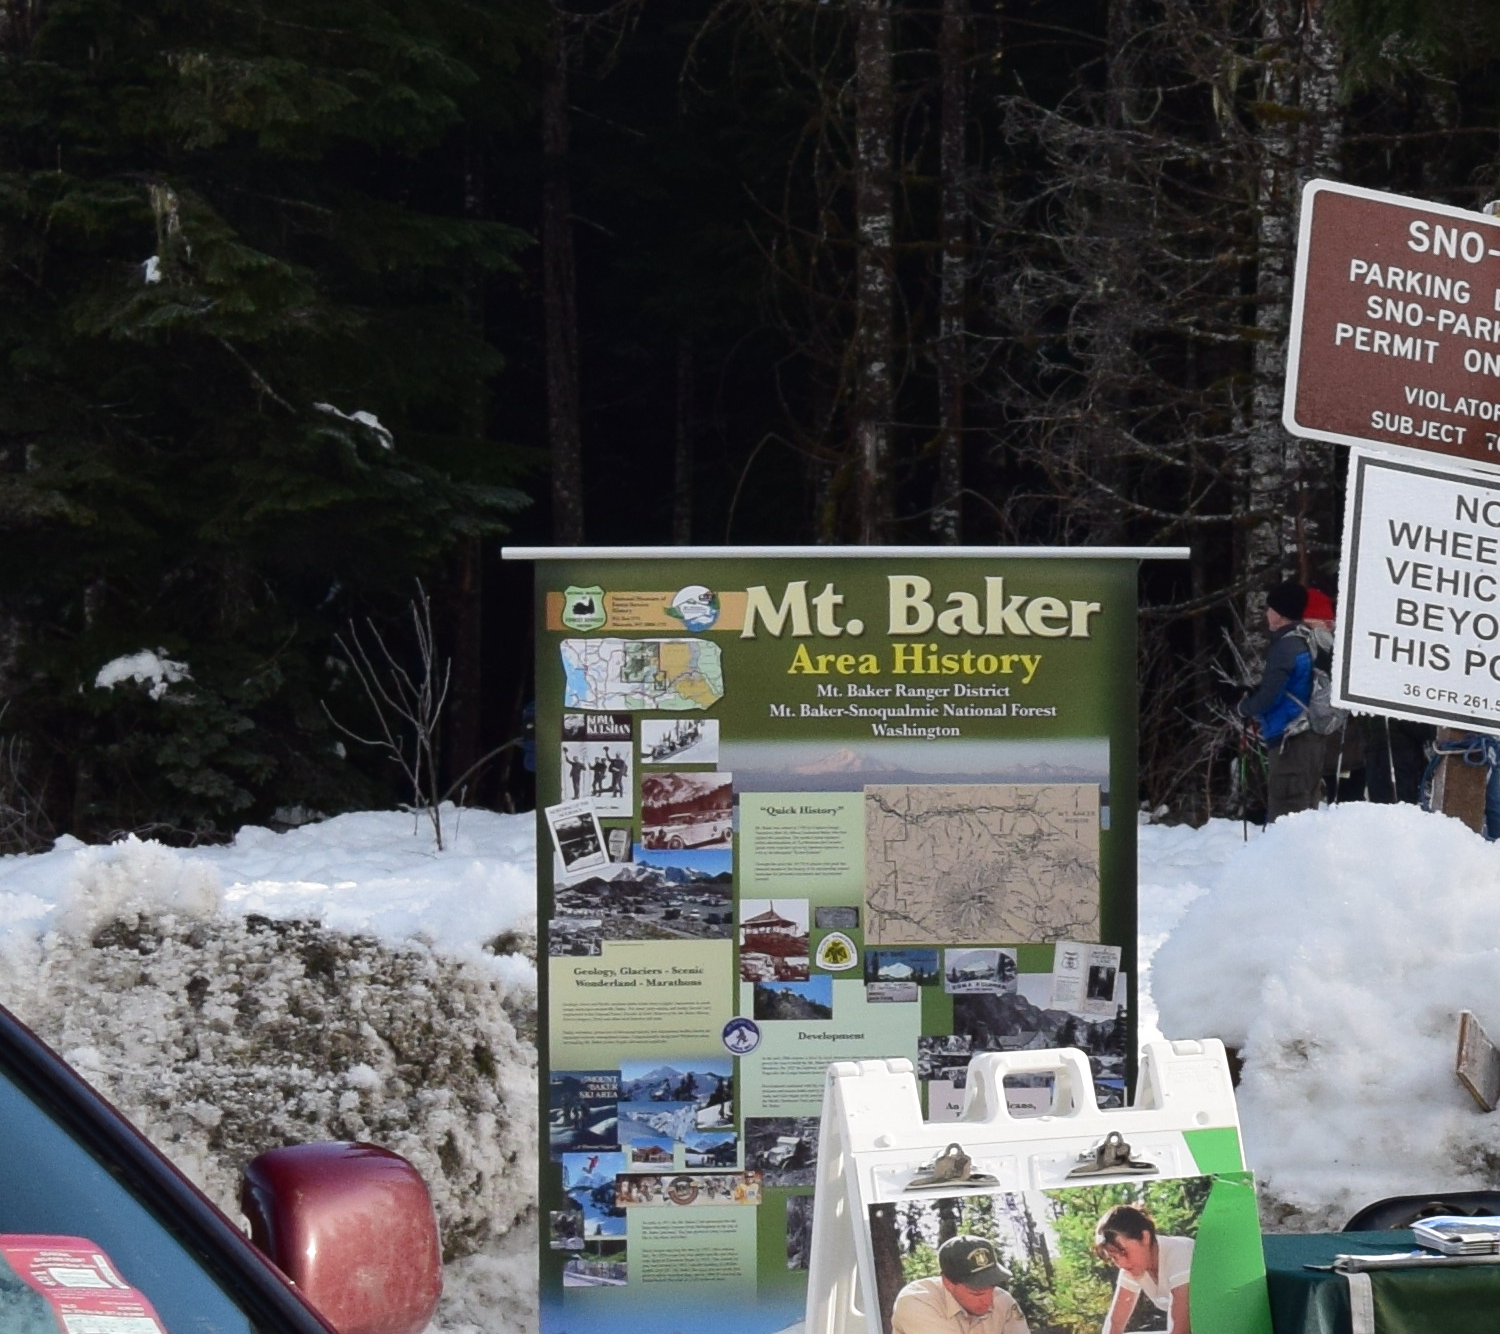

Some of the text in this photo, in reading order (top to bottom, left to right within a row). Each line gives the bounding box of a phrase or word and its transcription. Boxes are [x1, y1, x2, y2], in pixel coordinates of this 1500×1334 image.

[1350, 259, 1471, 305] PARKING
[1335, 323, 1439, 365] PERMIT
[1371, 411, 1466, 446] SUBJECT
[740, 575, 1101, 638] Mt. Baker
[1368, 632, 1451, 671] THIS
[787, 643, 1042, 684] Area History
[816, 683, 1010, 701] Mt. Baker Ranger District
[1403, 683, 1420, 697] 36
[1425, 686, 1459, 704] CFR
[770, 703, 1057, 721] Mt. Baker-Snoqualmie National Forest
[871, 723, 960, 739] Washington
[573, 966, 617, 978] Geology,
[620, 966, 662, 976] Glaciers
[671, 966, 704, 976] Scenic
[575, 978, 636, 987] Wonderland
[646, 978, 702, 987] Marathons
[798, 1031, 865, 1042] Development
